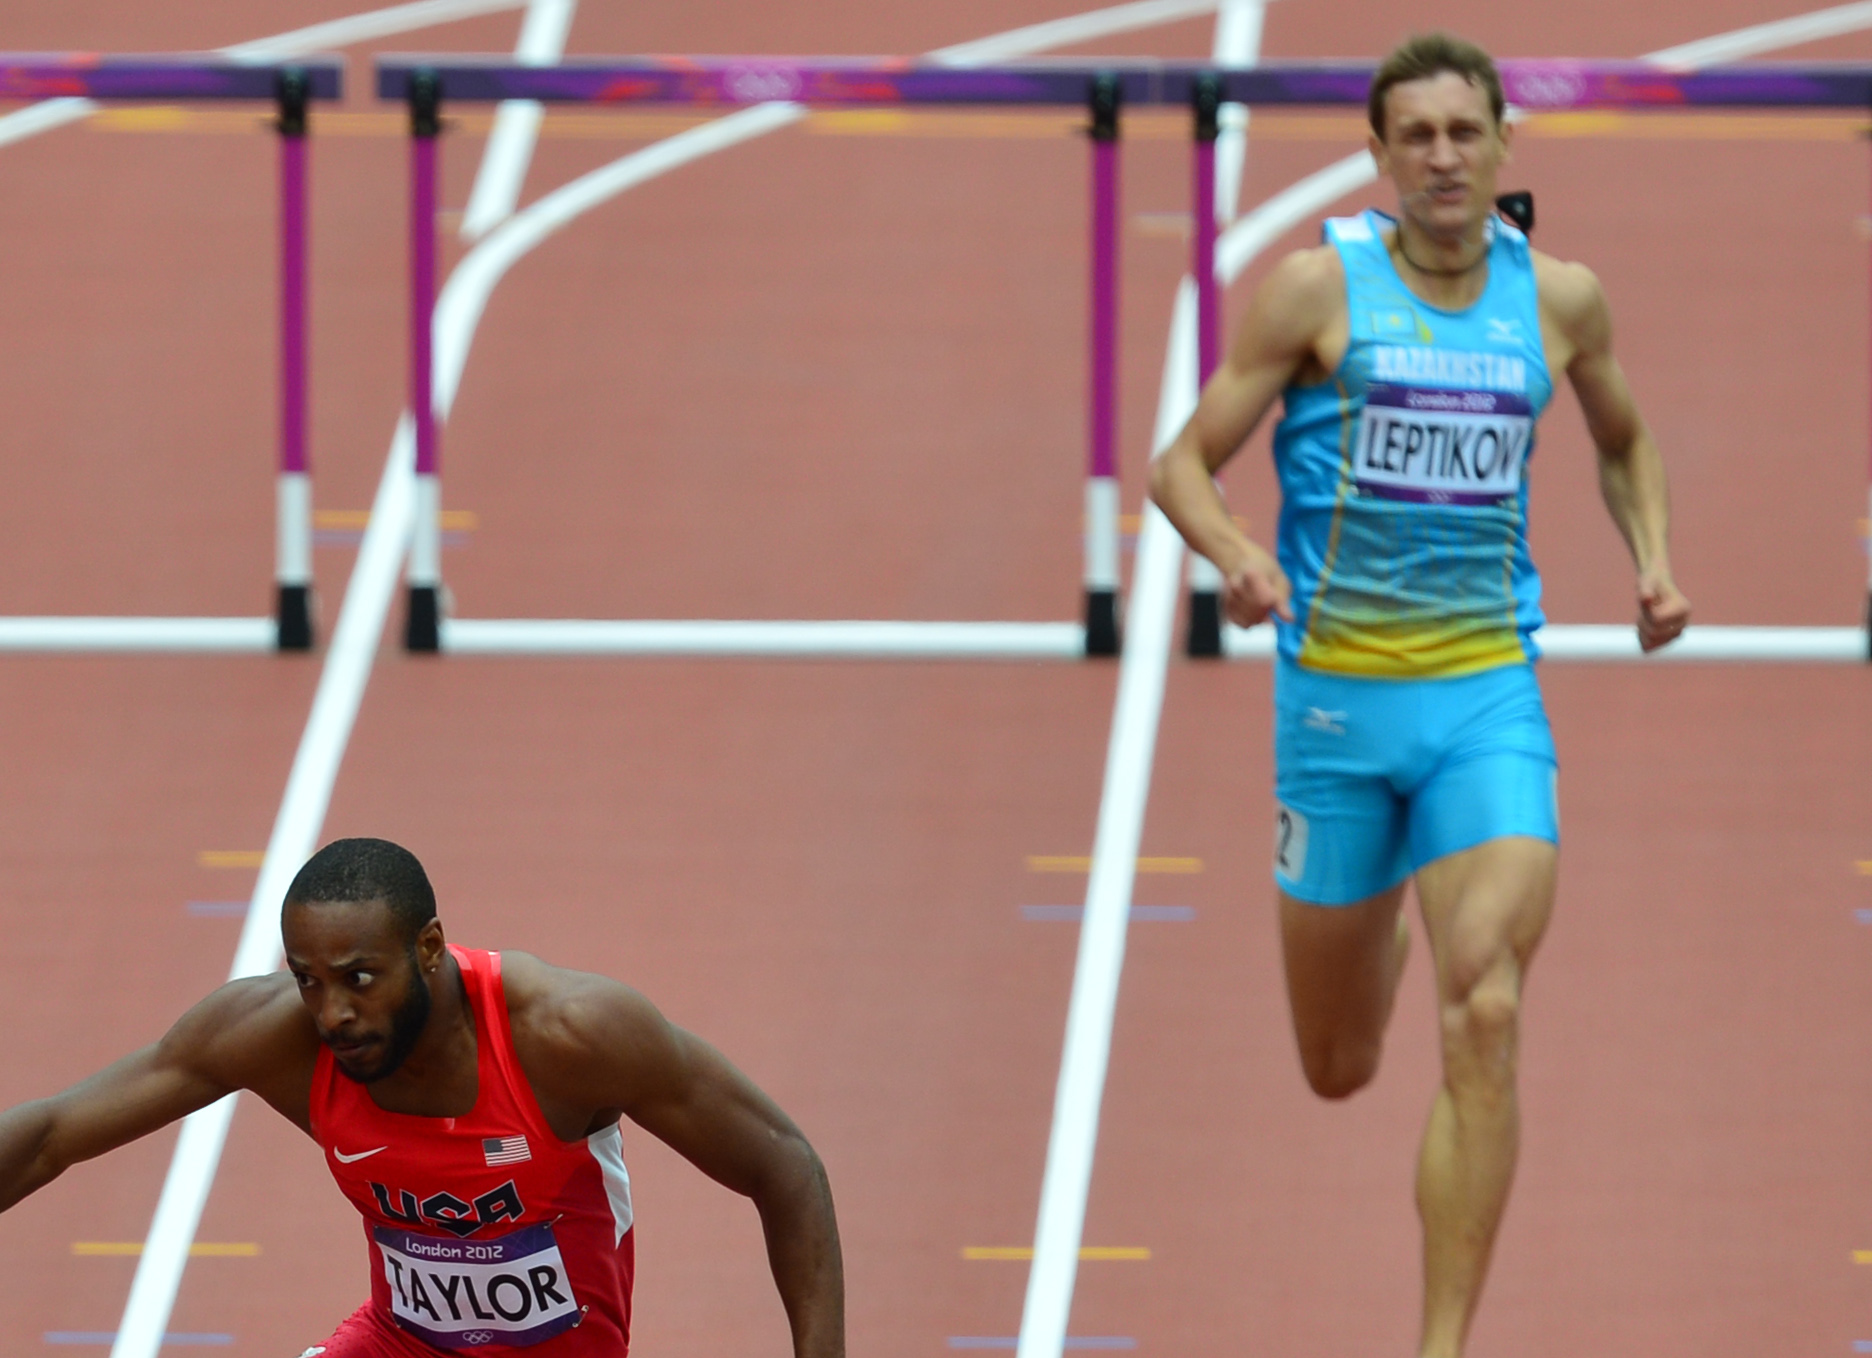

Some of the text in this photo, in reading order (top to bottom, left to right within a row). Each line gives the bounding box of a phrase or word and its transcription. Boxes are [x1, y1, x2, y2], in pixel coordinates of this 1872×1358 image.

[1367, 417, 1525, 481] LEPTIKOV
[366, 1178, 526, 1239] USA
[405, 1237, 504, 1260] London 2012
[386, 1253, 569, 1323] TAYLOR
